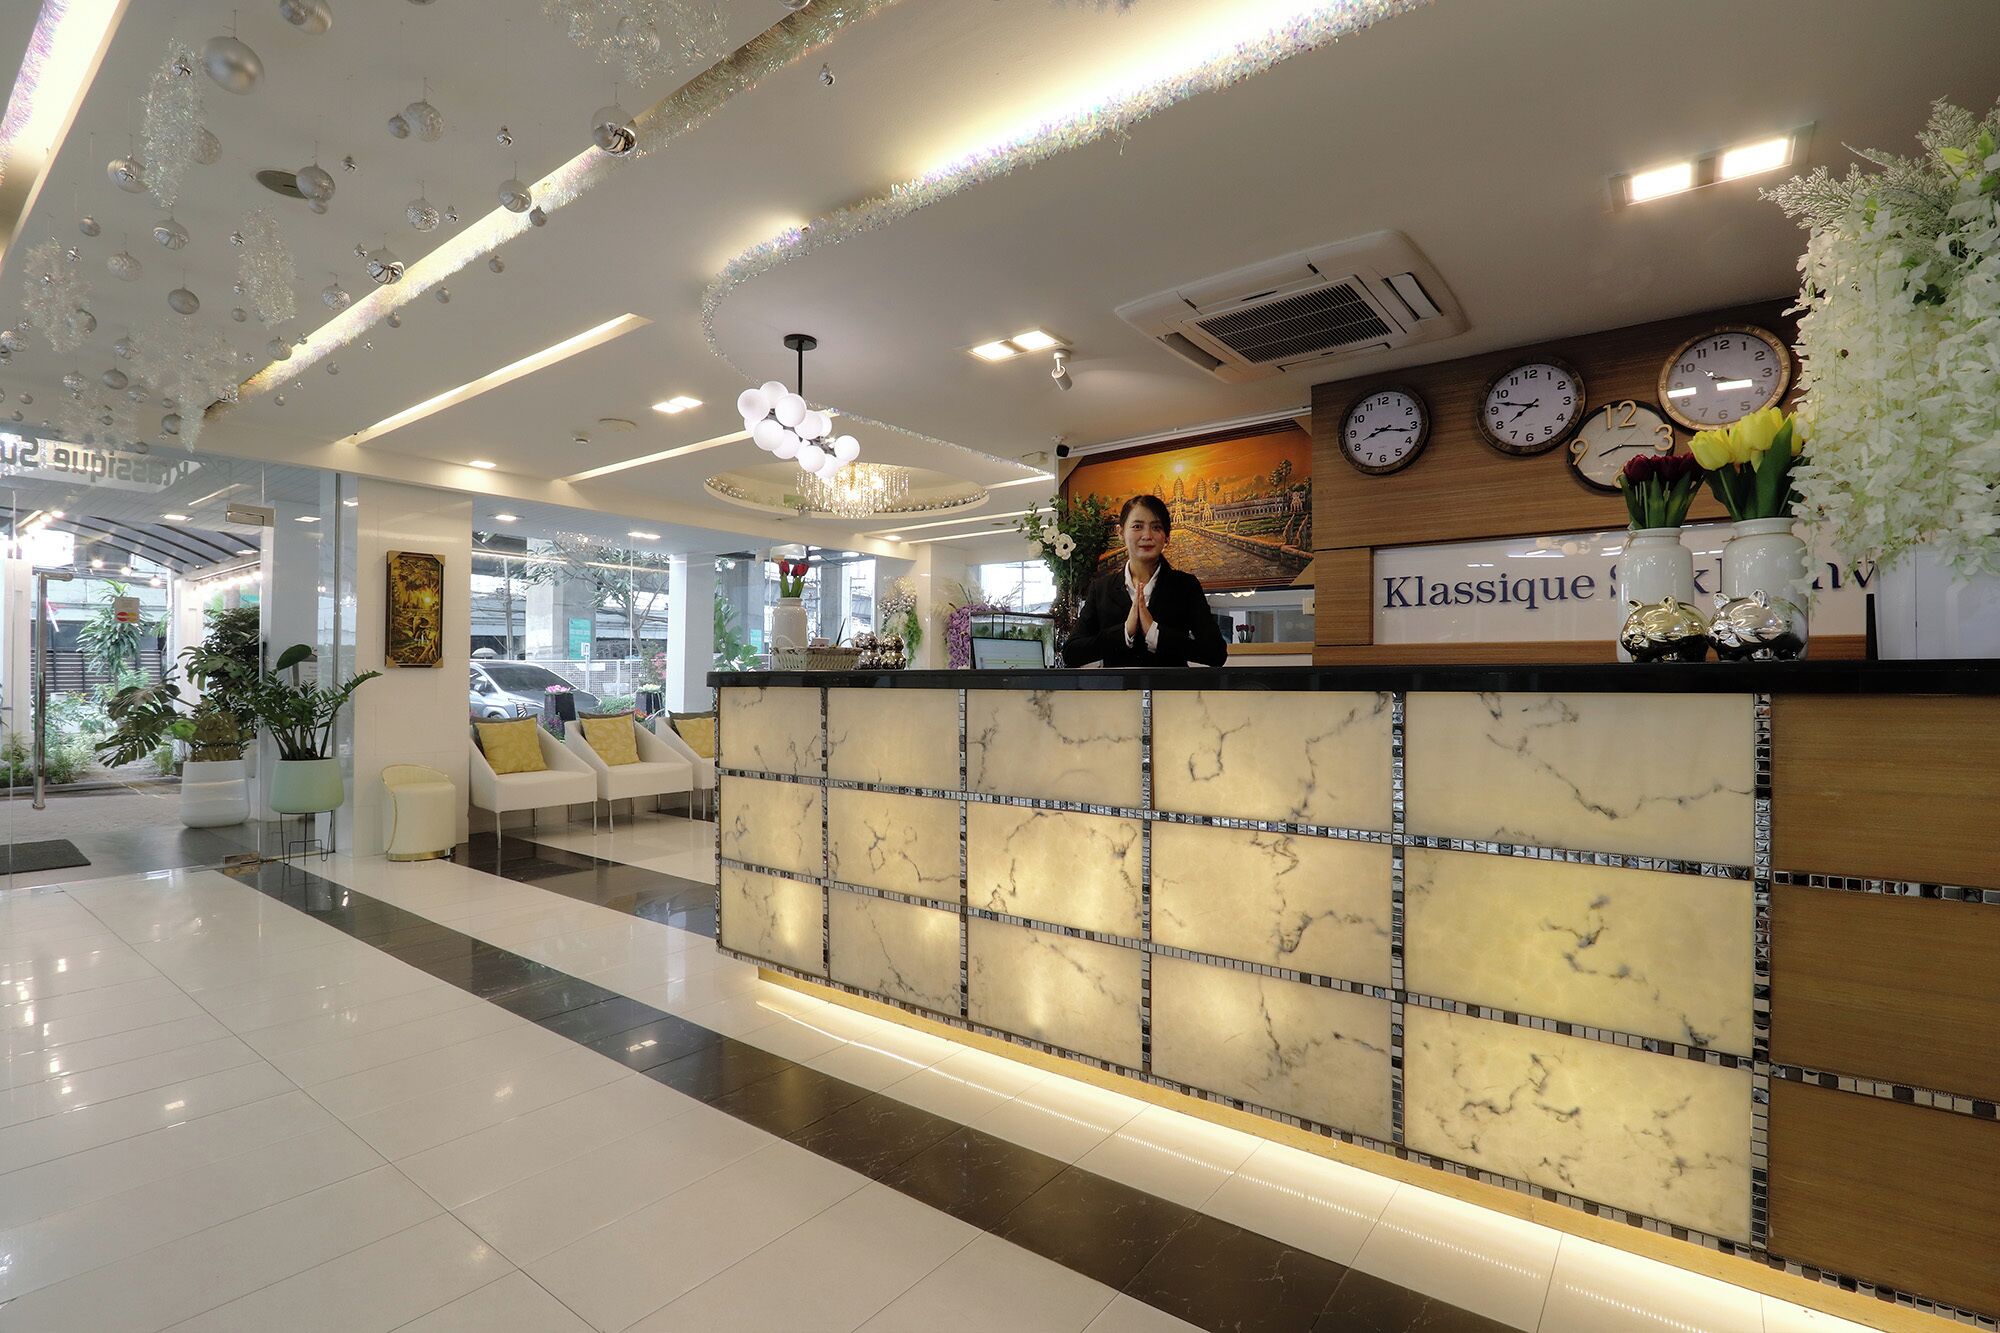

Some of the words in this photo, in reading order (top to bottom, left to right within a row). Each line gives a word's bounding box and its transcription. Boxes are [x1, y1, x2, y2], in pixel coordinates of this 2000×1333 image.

[1713, 340, 1730, 351] 12
[1741, 341, 1747, 351] 1
[1696, 348, 1707, 359] 11
[1754, 351, 1765, 361] 2
[1680, 363, 1696, 374] 10
[1762, 367, 1773, 378] 3
[1524, 369, 1538, 379] 12
[1547, 371, 1552, 380] 1
[1509, 377, 1519, 386] 11
[1557, 380, 1566, 390] 2
[1495, 389, 1509, 399] 10
[1755, 386, 1766, 396] 4
[1377, 396, 1389, 406] 12
[1396, 398, 1401, 407] 1
[1563, 396, 1571, 405] 3
[1681, 398, 1691, 407] 8
[1365, 403, 1373, 412] 11
[1490, 406, 1499, 415] 9
[1740, 401, 1751, 411] 5
[1405, 407, 1413, 416] 2
[1602, 400, 1637, 431] 12
[1698, 407, 1708, 417] 7
[1718, 409, 1728, 419] 6
[1354, 415, 1365, 424] 10
[1556, 413, 1565, 422] 4
[1410, 421, 1418, 430] 3
[1495, 420, 1504, 430] 8
[1349, 430, 1357, 439] 9
[1509, 430, 1518, 439] 7
[1544, 426, 1553, 435] 5
[1404, 436, 1413, 444] 4
[1526, 433, 1534, 442] 6
[1655, 423, 1674, 452] 3
[1354, 443, 1361, 452] 8
[1569, 438, 1589, 466] 9
[1366, 452, 1373, 461] 7
[1395, 448, 1402, 457] 5
[1379, 454, 1387, 463] 6
[1382, 573, 1596, 610] Klassique
